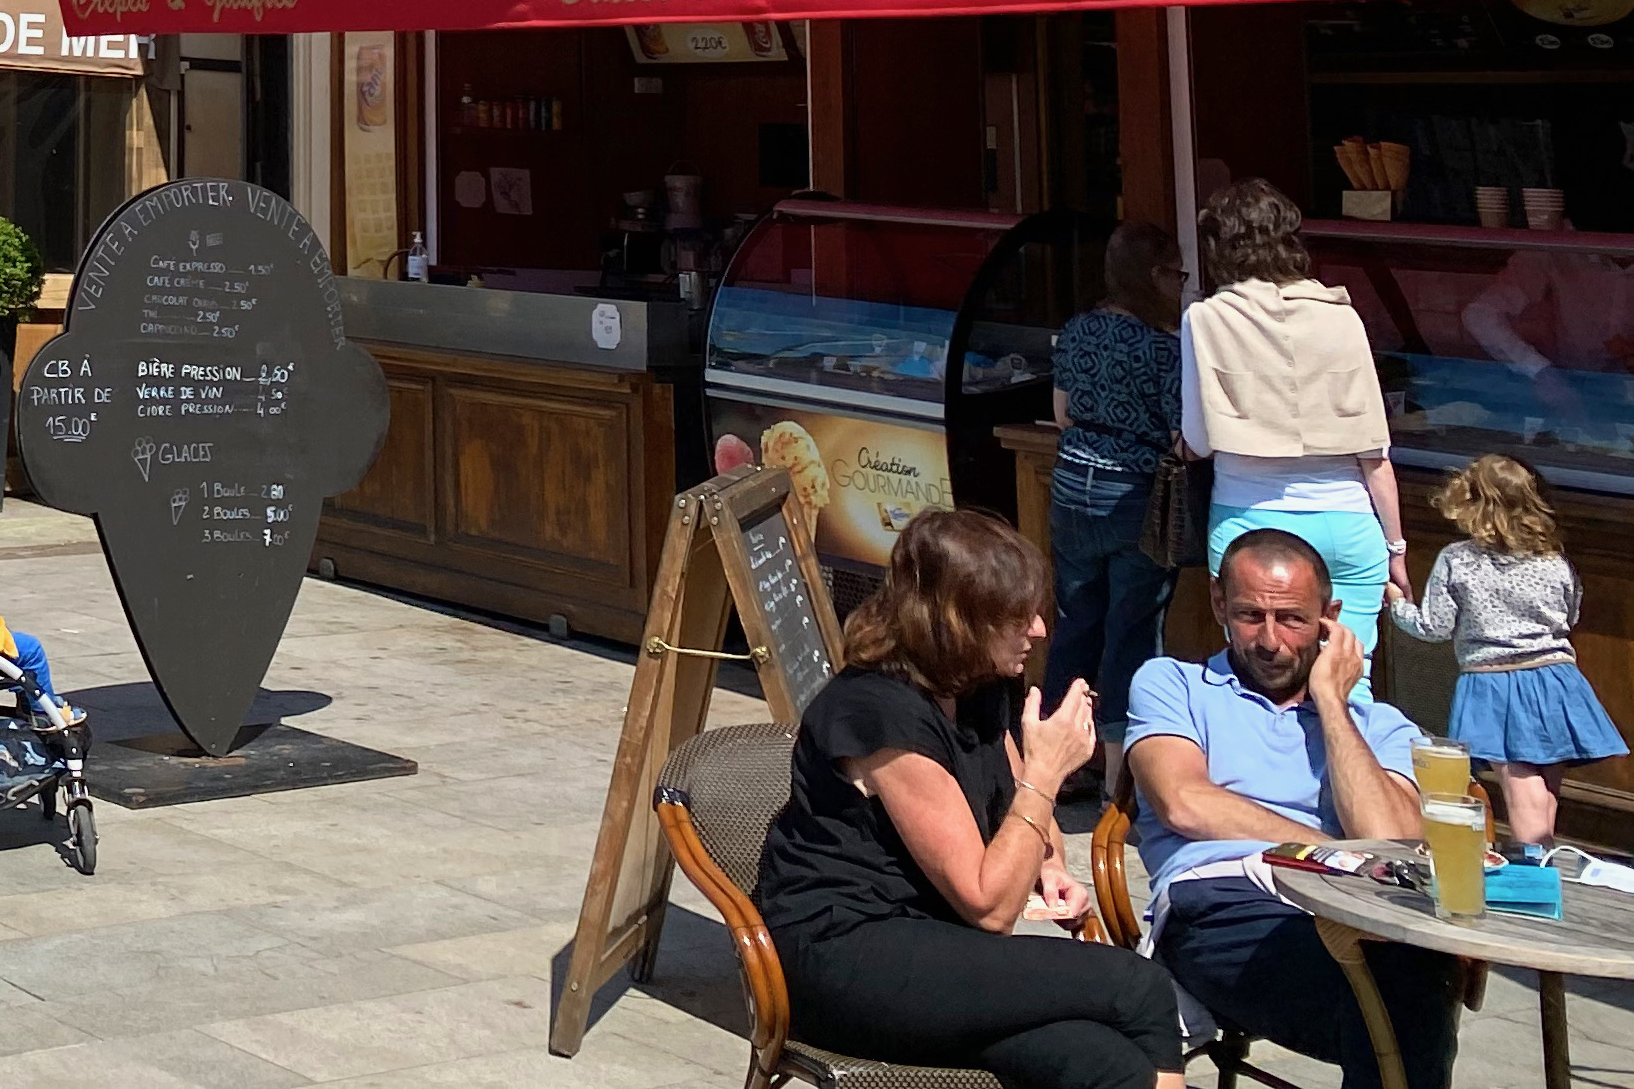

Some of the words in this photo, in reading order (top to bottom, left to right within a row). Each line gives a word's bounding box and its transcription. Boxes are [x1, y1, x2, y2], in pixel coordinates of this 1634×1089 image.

[247, 186, 306, 241] VENTE
[77, 232, 125, 311] VENTE
[179, 261, 227, 274] EXPRESSO
[43, 360, 72, 379] CB
[137, 356, 175, 380] BIÈRE
[94, 386, 113, 404] DE
[136, 383, 177, 400] VERRE
[179, 385, 195, 400] DE
[199, 385, 224, 399] VIN
[159, 442, 214, 465] GLACES
[857, 446, 920, 478] Création
[199, 481, 208, 498] 1
[831, 458, 954, 509] GOURMANDE
[202, 505, 211, 519] 2
[199, 529, 212, 543] 3
